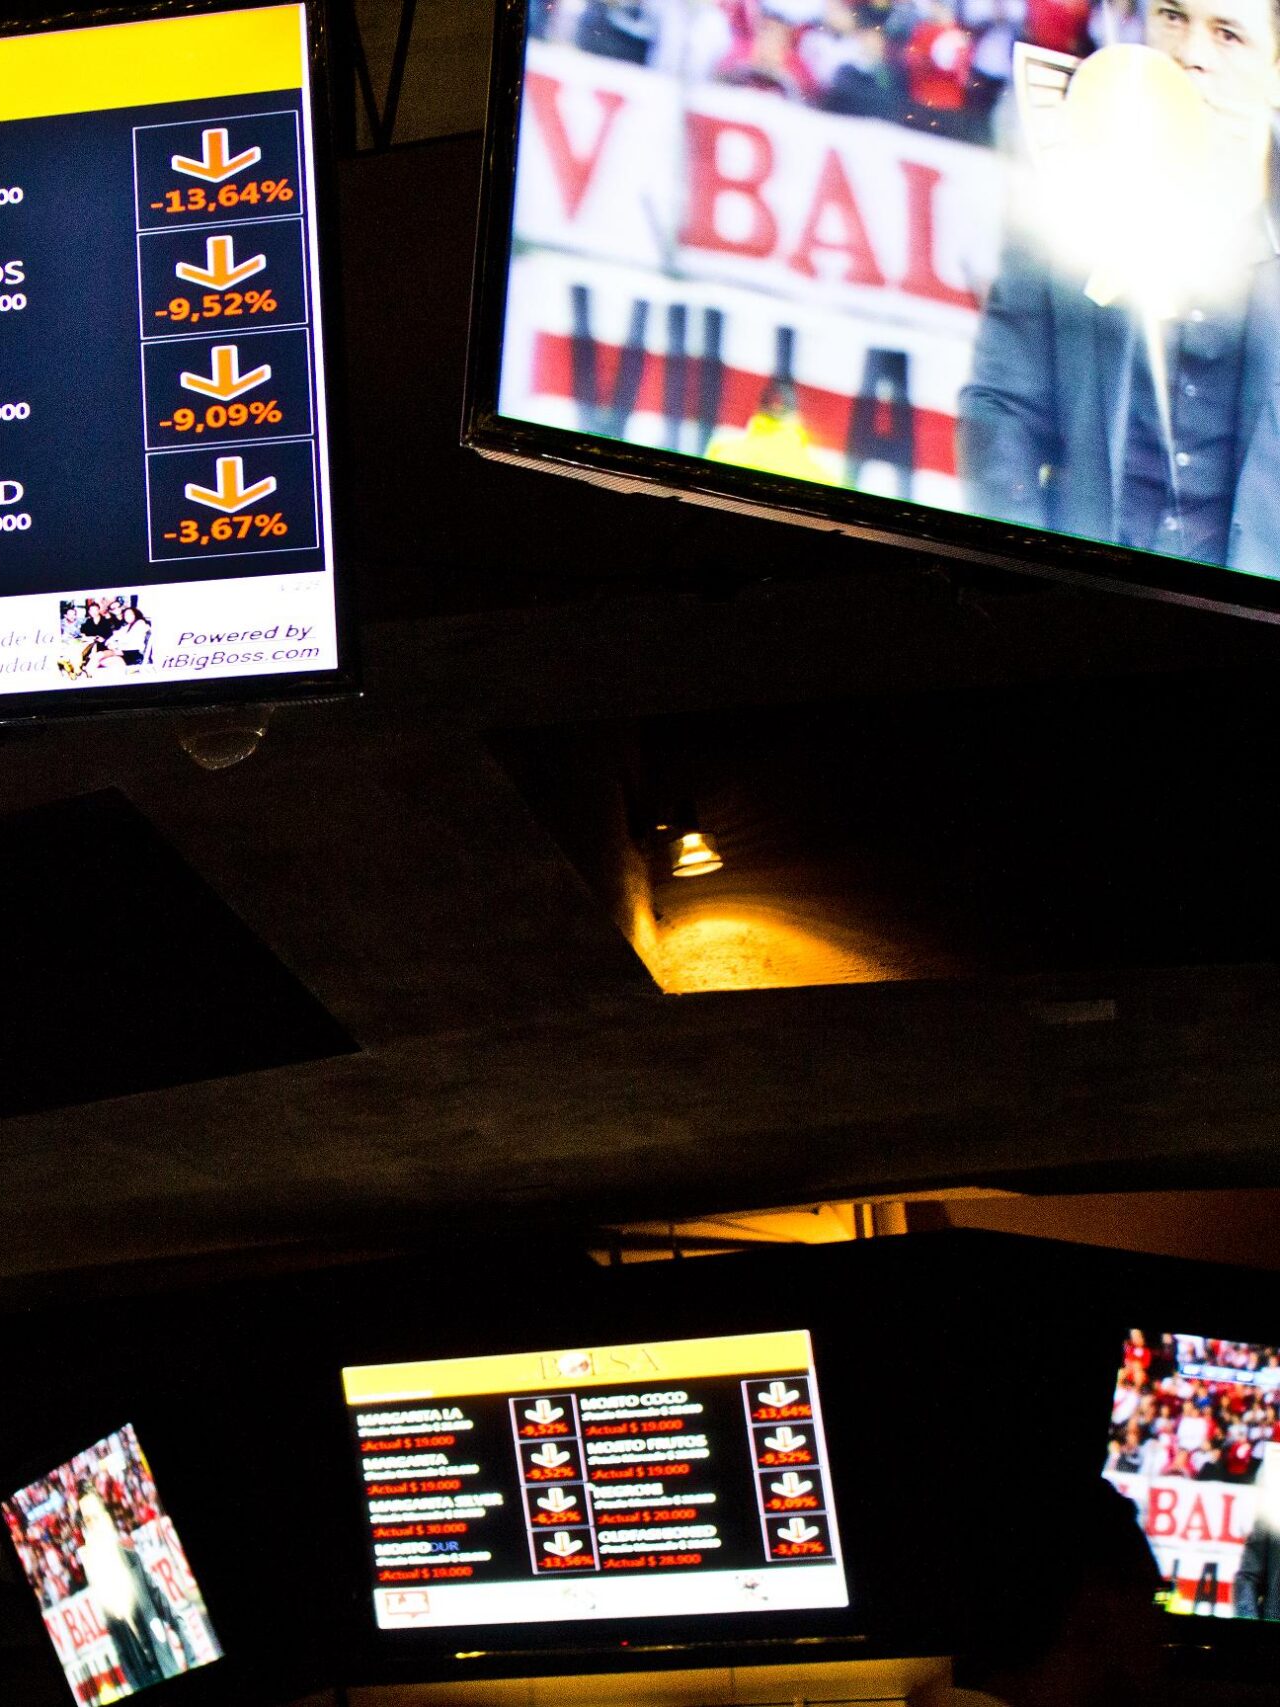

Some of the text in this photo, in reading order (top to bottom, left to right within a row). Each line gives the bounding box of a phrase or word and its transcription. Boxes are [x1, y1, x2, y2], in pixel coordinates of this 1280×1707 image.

[151, 179, 293, 213] -13,64%
[155, 290, 277, 322] -9,52%
[160, 400, 282, 432] -9,09%
[164, 513, 287, 545] -3,67%
[178, 622, 314, 645] Powered by
[162, 648, 319, 670] itBigBoss.com
